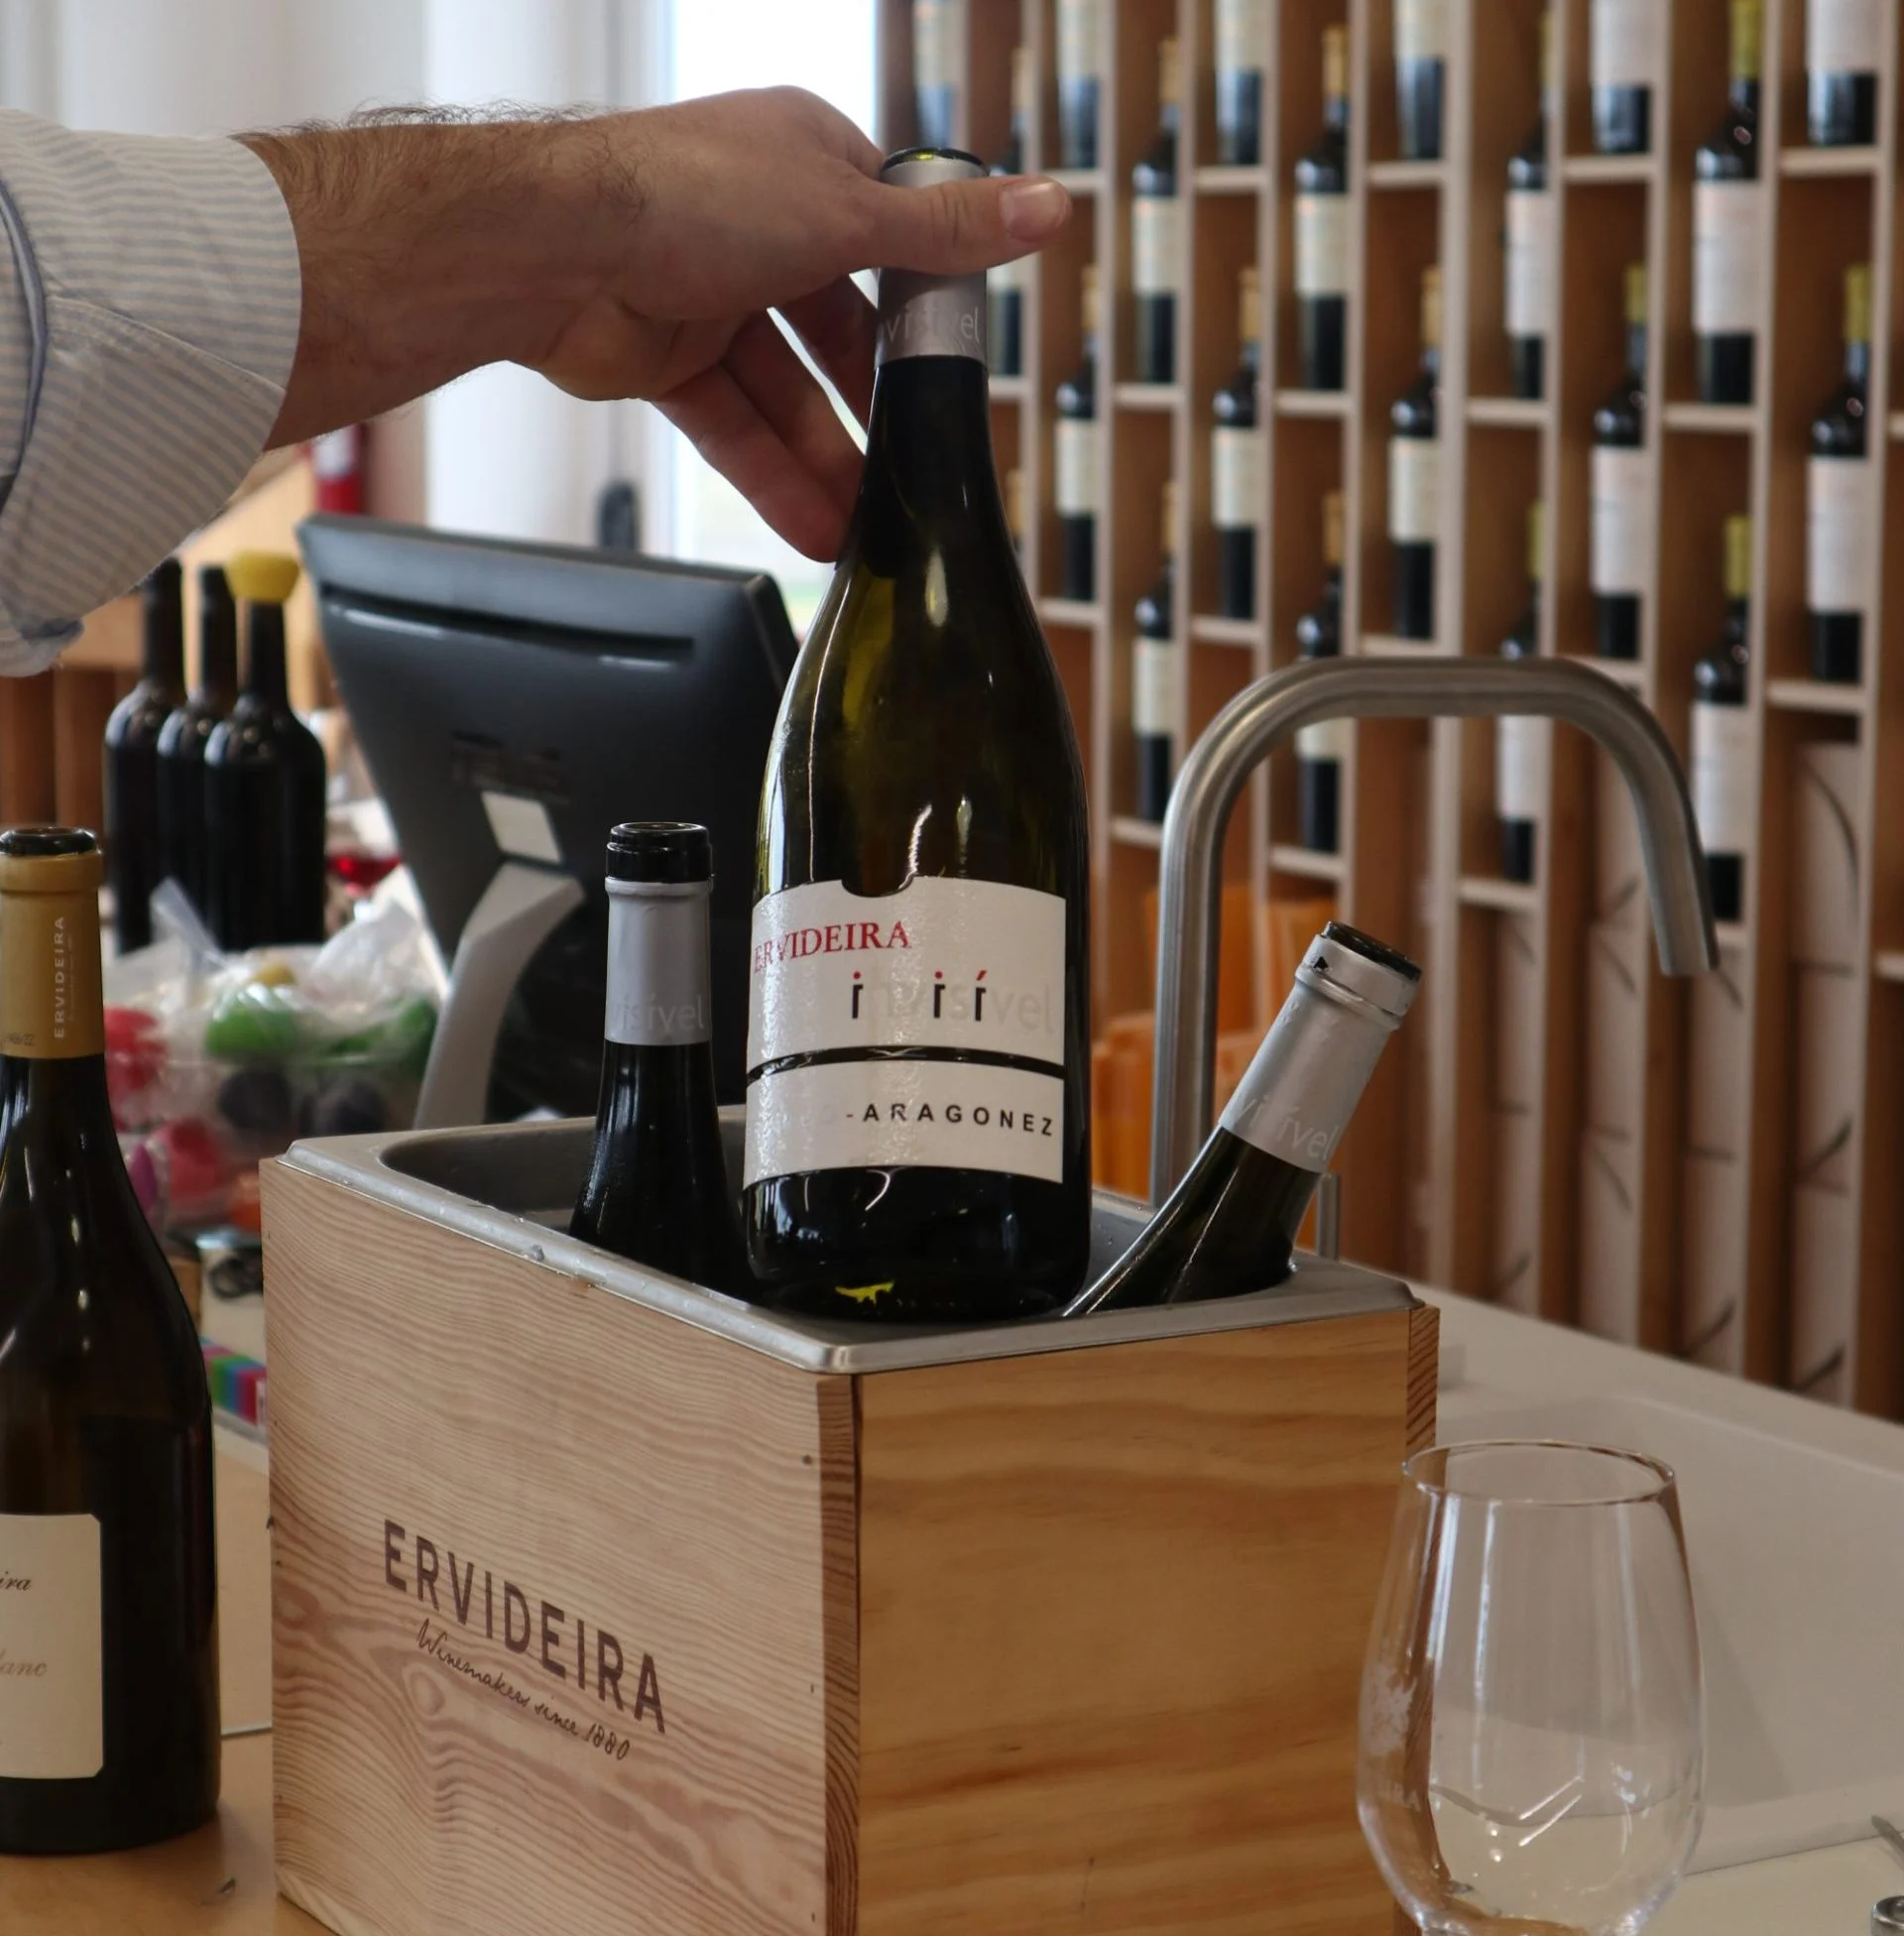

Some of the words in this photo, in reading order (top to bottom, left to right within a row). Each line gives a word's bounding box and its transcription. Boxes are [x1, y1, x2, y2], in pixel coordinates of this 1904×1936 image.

[54, 916, 65, 1039] ERVIDEIRA
[754, 920, 912, 973] ERVIDEIRA
[384, 1518, 665, 1735] ERVIDEIRA
[416, 1618, 532, 1707] Winemakers
[535, 1697, 579, 1737] since
[581, 1723, 631, 1761] 1880
